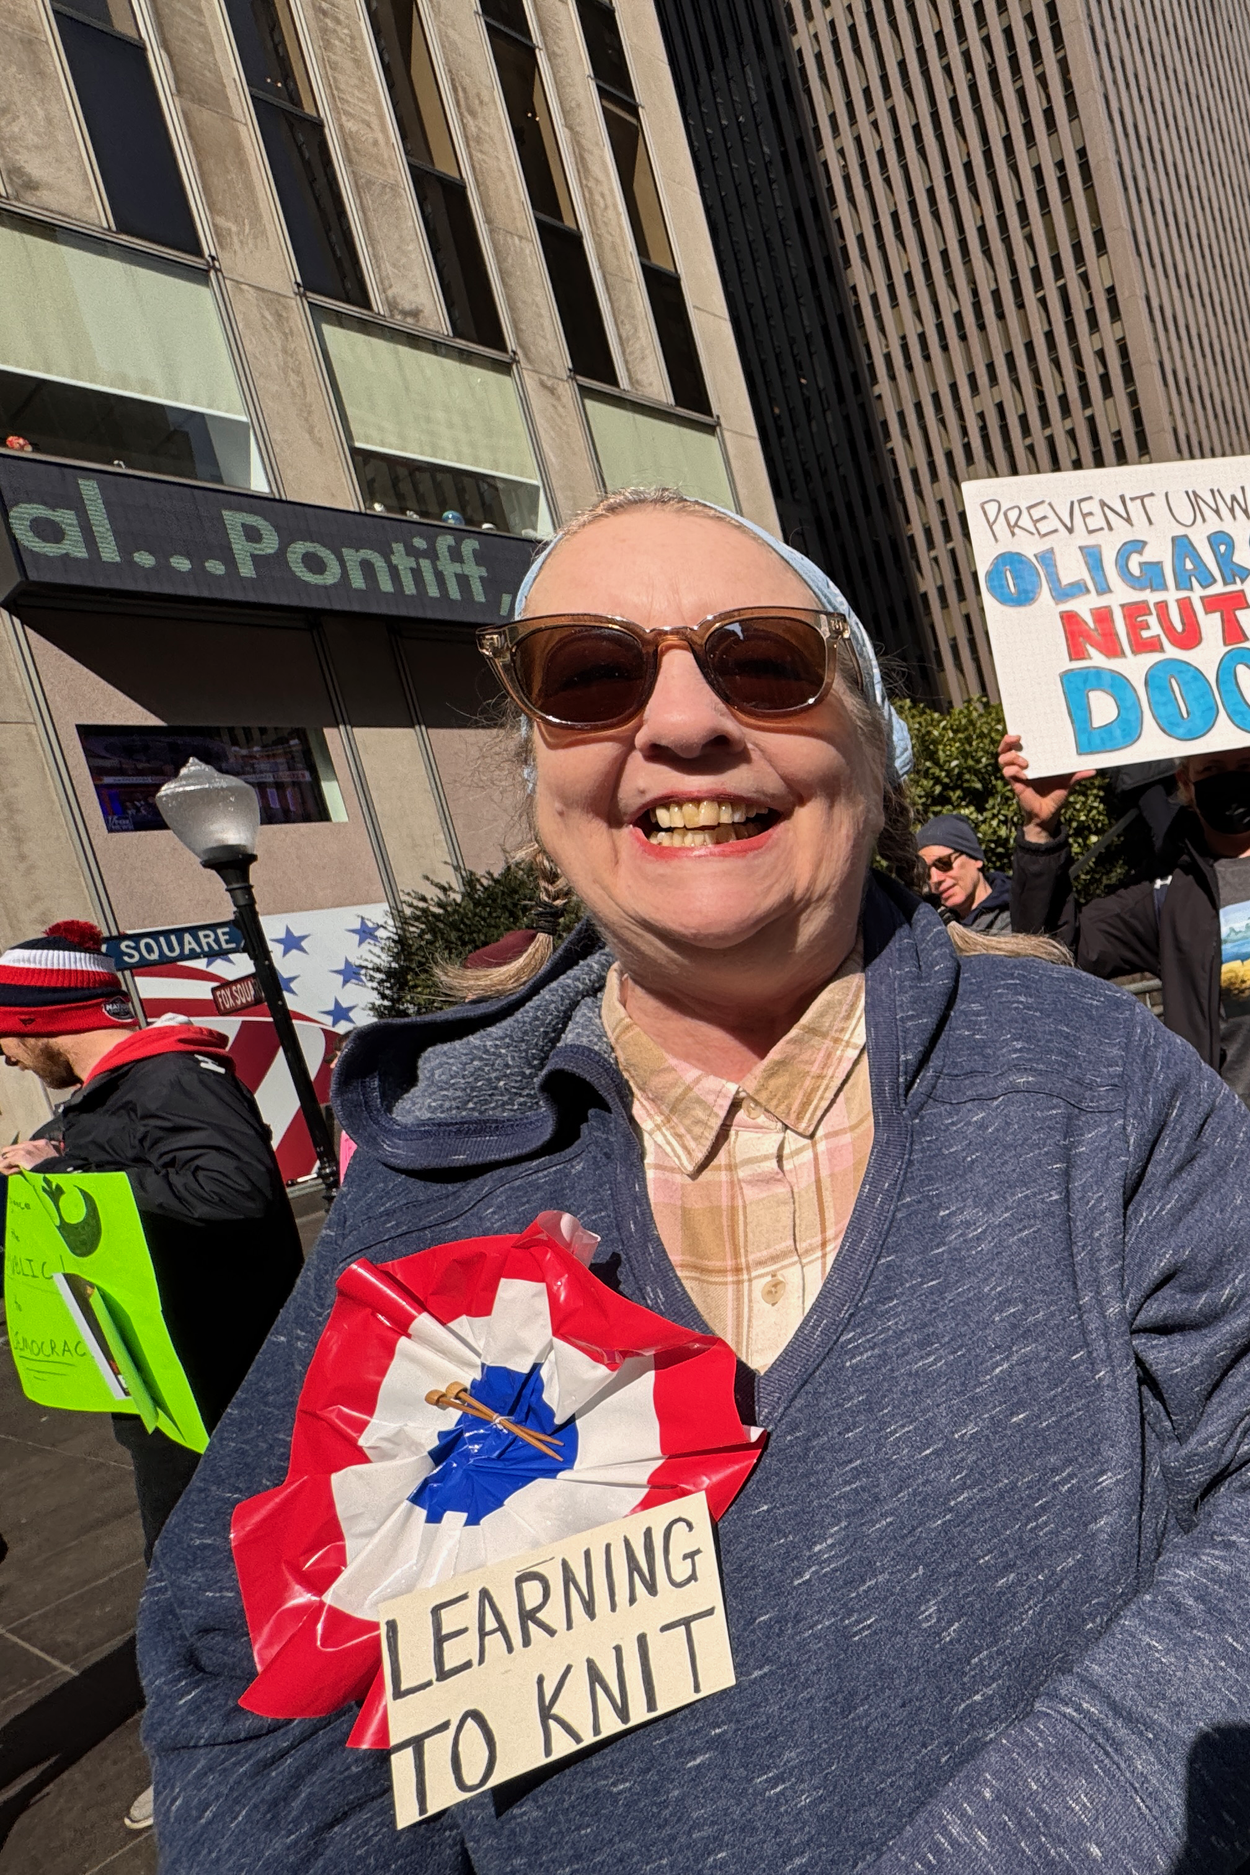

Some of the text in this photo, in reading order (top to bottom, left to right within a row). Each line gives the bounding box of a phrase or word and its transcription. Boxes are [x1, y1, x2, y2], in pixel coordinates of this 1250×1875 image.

[980, 491, 1156, 543] PREVENT
[120, 927, 236, 963] SQUARE
[216, 987, 235, 1010] FOX
[385, 1516, 703, 1701] LEARNING
[390, 1606, 716, 1817] TO KNIT
